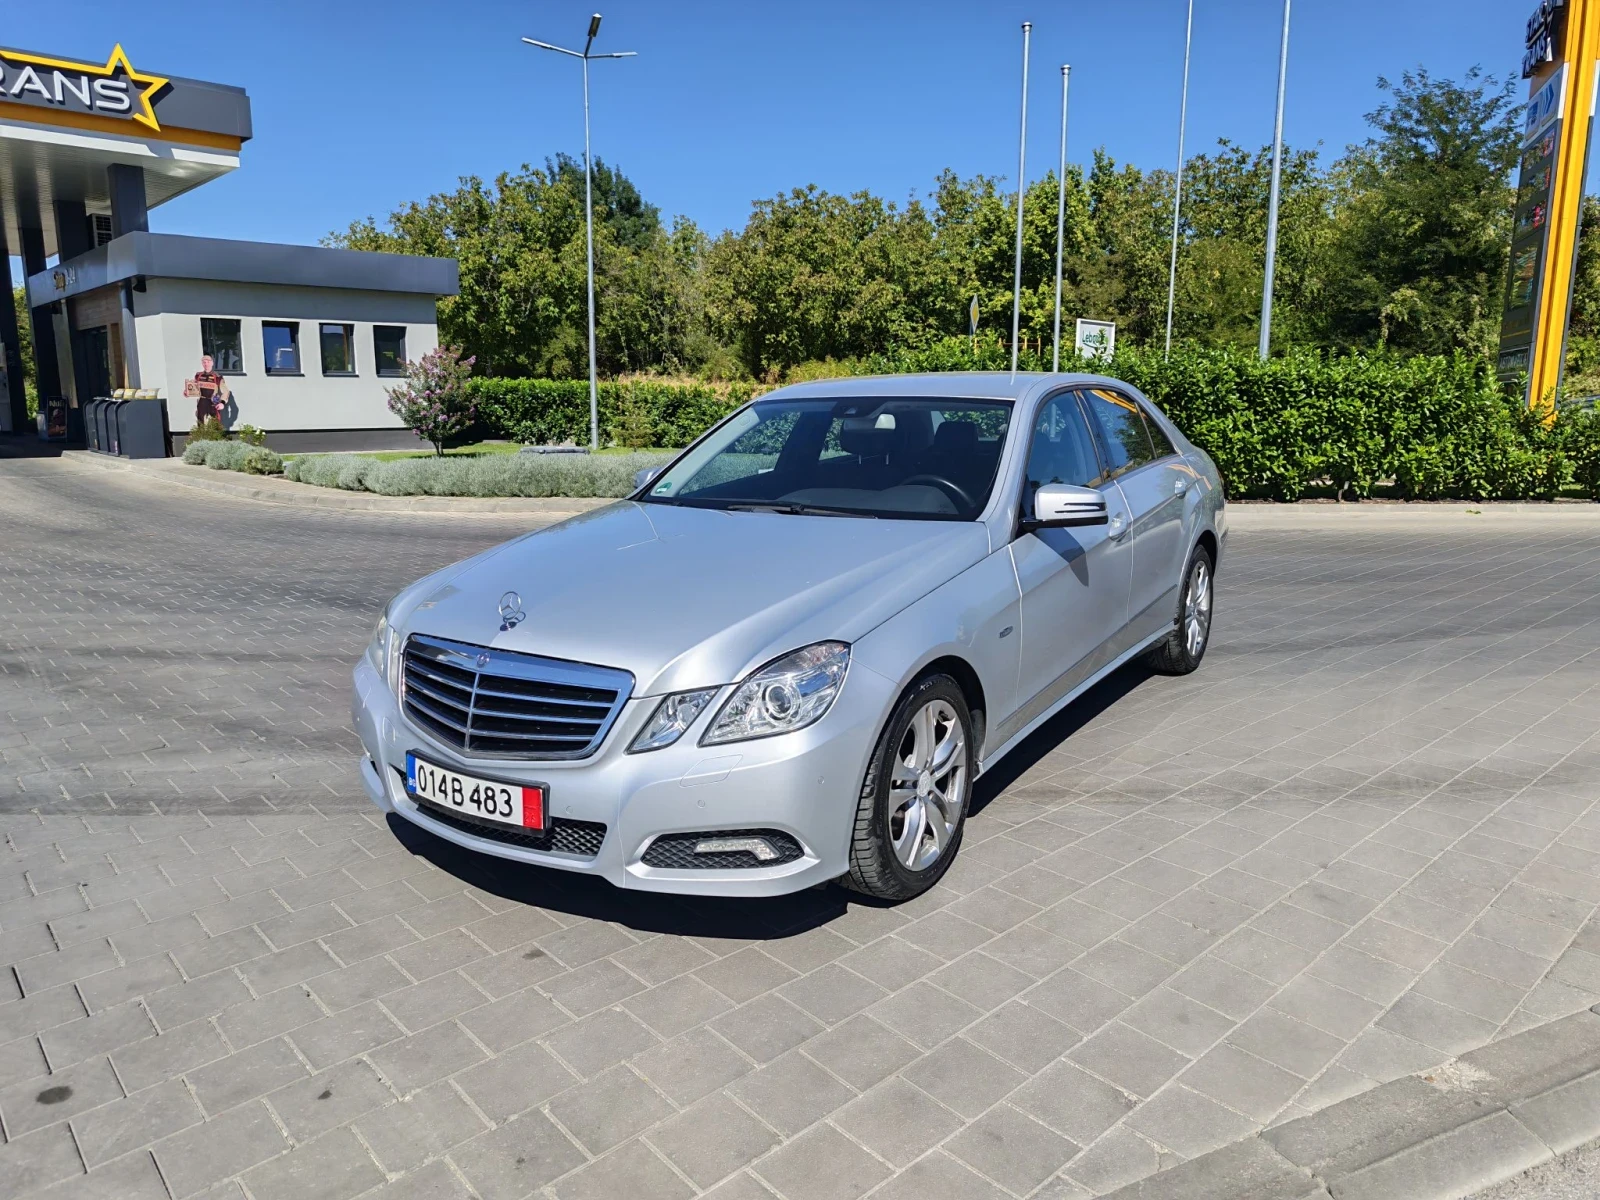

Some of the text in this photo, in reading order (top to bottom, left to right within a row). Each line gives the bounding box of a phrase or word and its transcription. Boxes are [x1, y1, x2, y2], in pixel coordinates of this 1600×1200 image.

[0, 65, 131, 111] ANS
[418, 765, 513, 817] 014B 483
